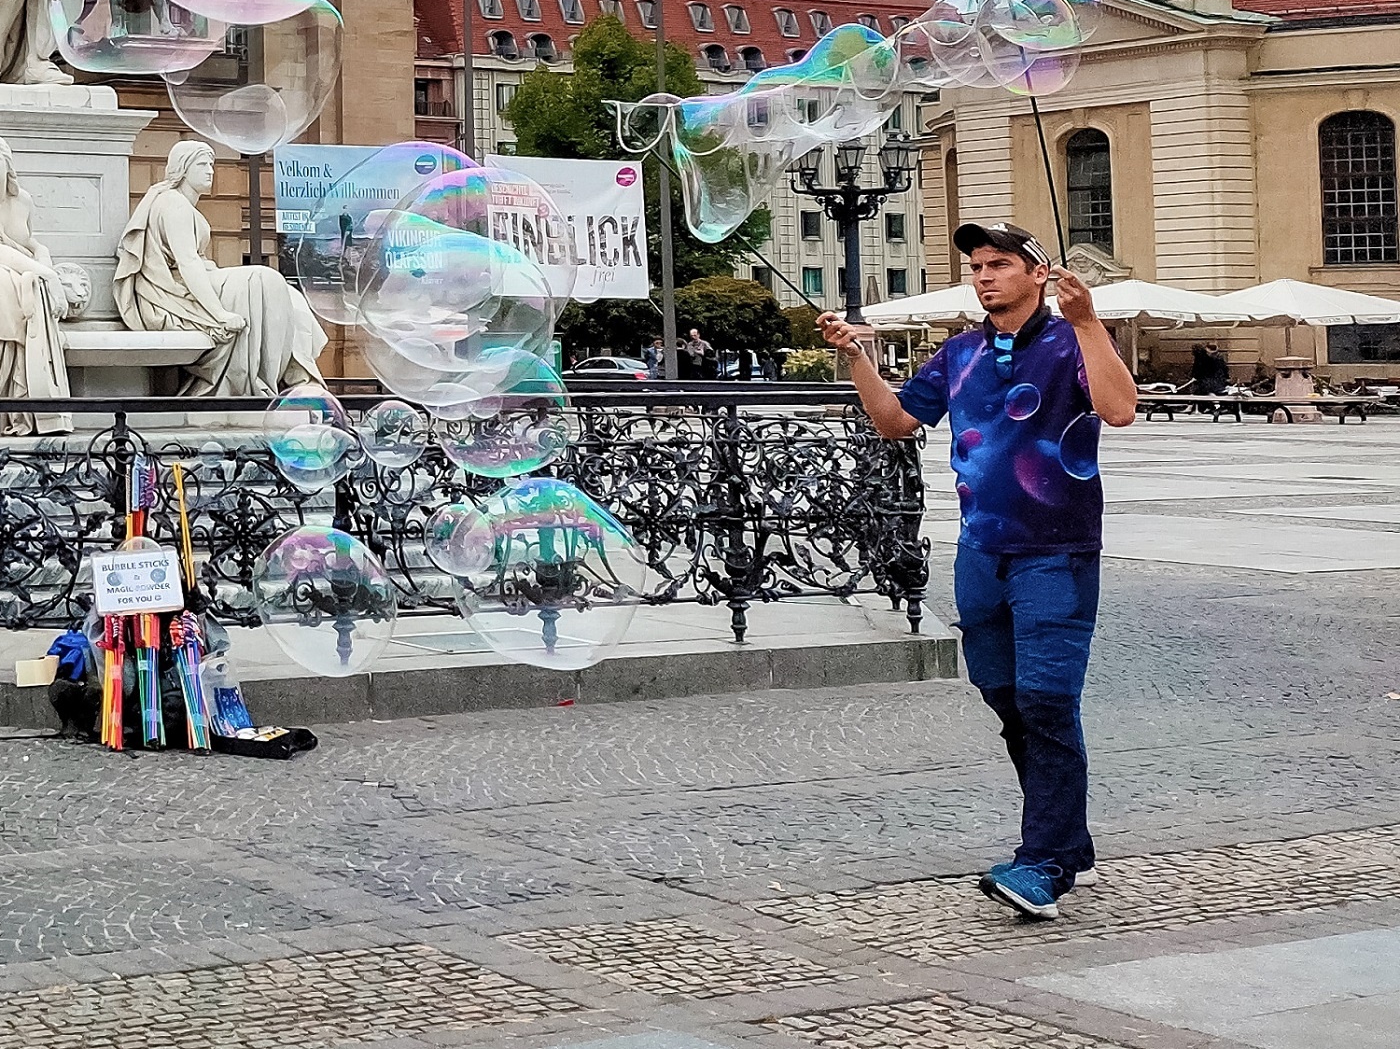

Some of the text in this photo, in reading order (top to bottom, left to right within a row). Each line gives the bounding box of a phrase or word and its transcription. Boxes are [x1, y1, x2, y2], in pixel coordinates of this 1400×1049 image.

[323, 163, 332, 178] &
[280, 182, 400, 200] Herzlich Willkommen
[492, 211, 643, 268] EINBLICK
[590, 266, 616, 287] frei
[102, 560, 170, 572] BUBBLE STICKS
[118, 595, 153, 604] FOR YOU
